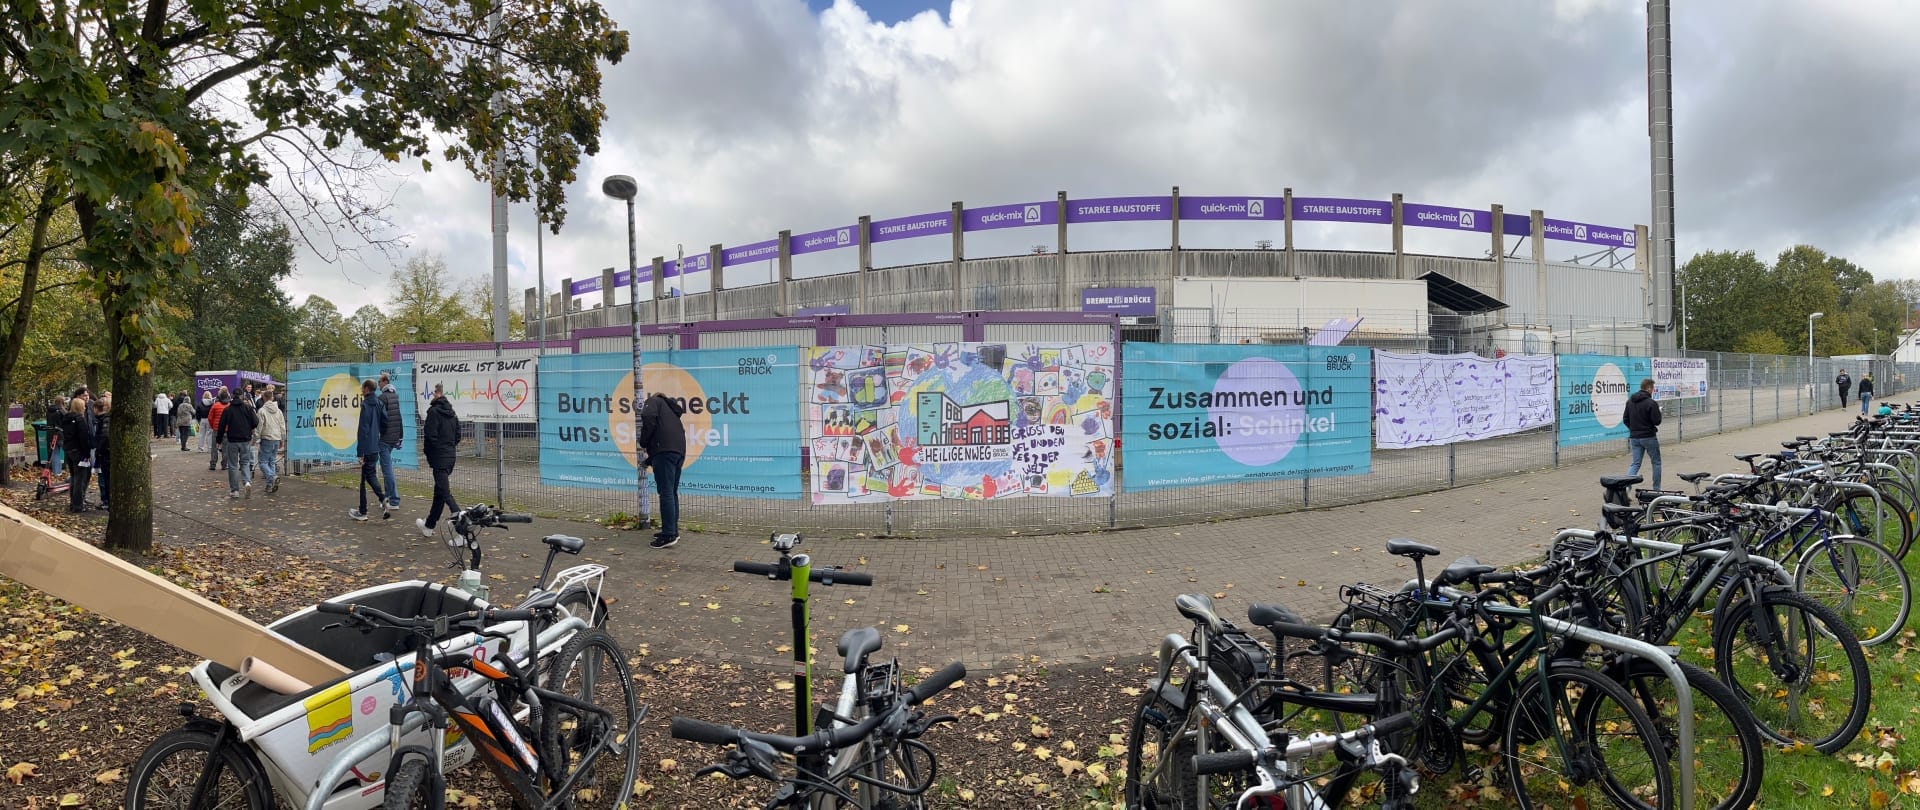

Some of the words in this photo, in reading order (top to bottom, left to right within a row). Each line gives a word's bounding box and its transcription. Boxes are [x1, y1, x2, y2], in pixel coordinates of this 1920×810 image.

[1078, 206, 1111, 215] STARKE
[1112, 204, 1161, 213] BAUSTOFFE
[1200, 204, 1246, 214] quick-mix
[1303, 205, 1335, 214] STARKE
[1336, 206, 1382, 216] BAUSTOFFE
[981, 211, 1023, 223] quick-mix
[1417, 211, 1458, 223] quick-mix
[879, 224, 907, 235] STARKE
[907, 218, 948, 232] BAUSTOFFE
[804, 235, 837, 248] quick-mix
[1086, 297, 1113, 305] BREMER
[738, 357, 767, 367] OSNA
[1327, 355, 1348, 363] OSNA
[420, 362, 471, 374] SCHINKEL
[476, 361, 495, 372] IST
[497, 358, 532, 371] BUNT
[1568, 381, 1594, 395] Jede
[1595, 380, 1631, 394] Stimme
[296, 397, 317, 411] Hier
[317, 394, 348, 412] spielt
[351, 394, 364, 409] di
[558, 392, 613, 414] Bunt
[1148, 387, 1287, 410] Zusammen
[1294, 385, 1334, 406] und
[1568, 400, 1599, 415] zählt:
[295, 413, 338, 429] Zukunft:
[1148, 415, 1233, 441] sozial:
[1239, 411, 1336, 437] Schinkel
[558, 424, 609, 443] uns:
[1022, 463, 1048, 475] WELT
[1147, 478, 1179, 487] Weitere
[1180, 476, 1200, 485] Infos
